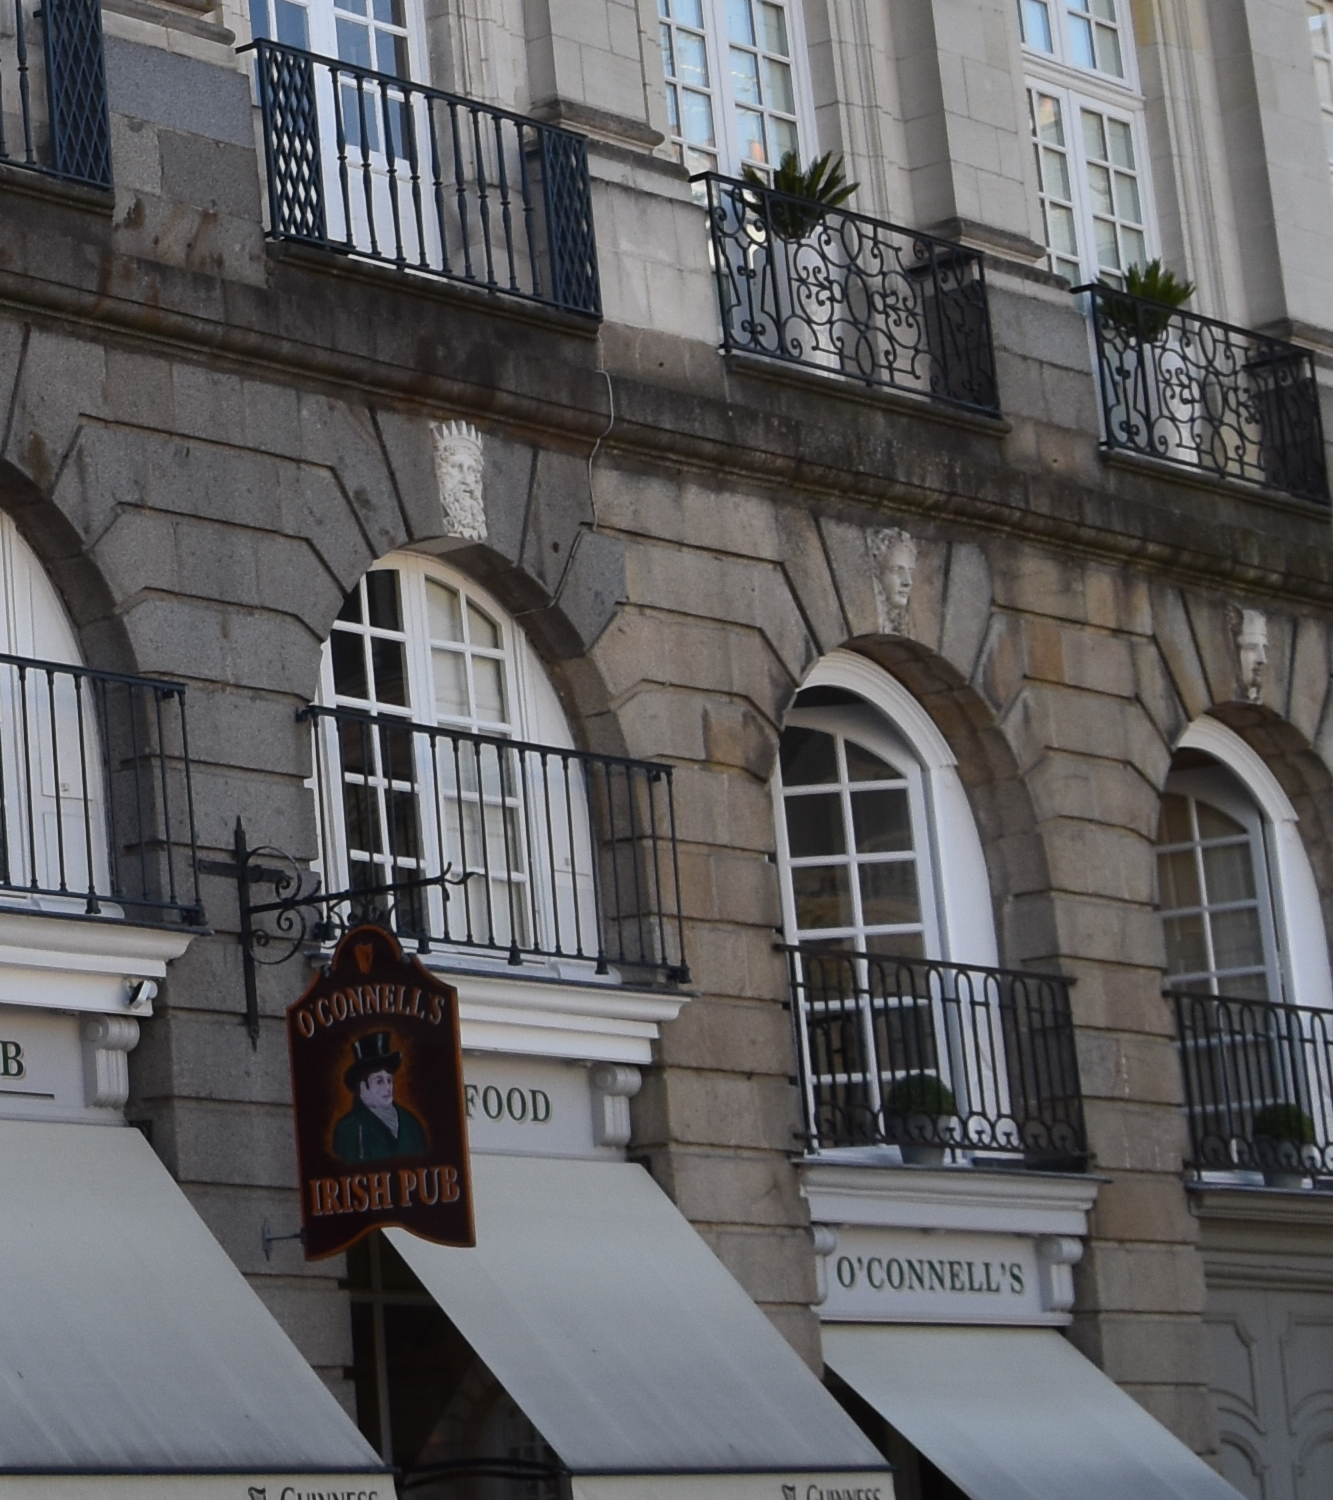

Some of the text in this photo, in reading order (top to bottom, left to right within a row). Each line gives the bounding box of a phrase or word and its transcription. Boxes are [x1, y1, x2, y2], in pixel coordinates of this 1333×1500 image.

[297, 983, 445, 1038] O'CONNELL'S
[464, 1083, 552, 1123] FOOD
[309, 1164, 461, 1216] IRISH PUB
[836, 1256, 1024, 1294] O'CONNELL'S
